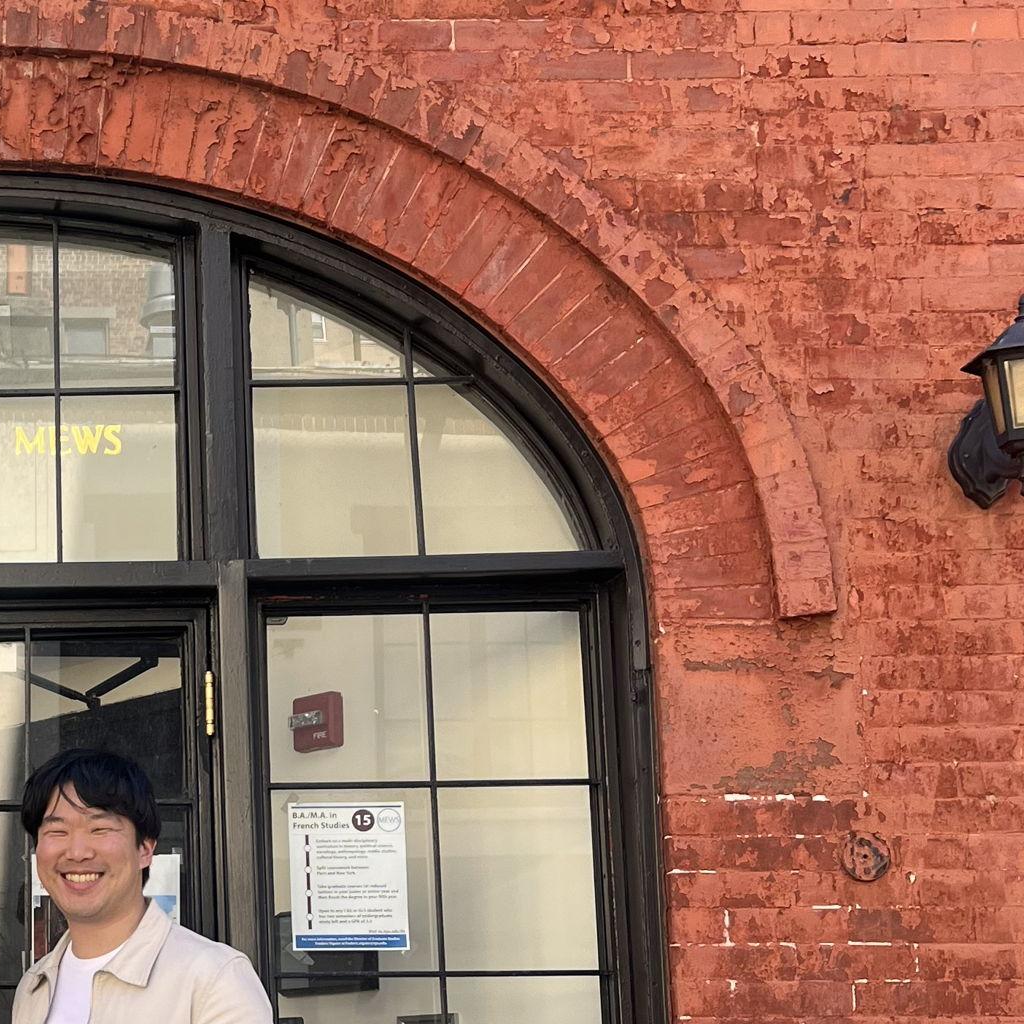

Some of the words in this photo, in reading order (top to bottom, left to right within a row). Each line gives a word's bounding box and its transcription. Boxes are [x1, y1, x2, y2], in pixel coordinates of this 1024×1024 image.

[15, 424, 122, 456] MEWS
[293, 821, 320, 830] French
[320, 821, 350, 829] Studies
[355, 814, 372, 826] 15
